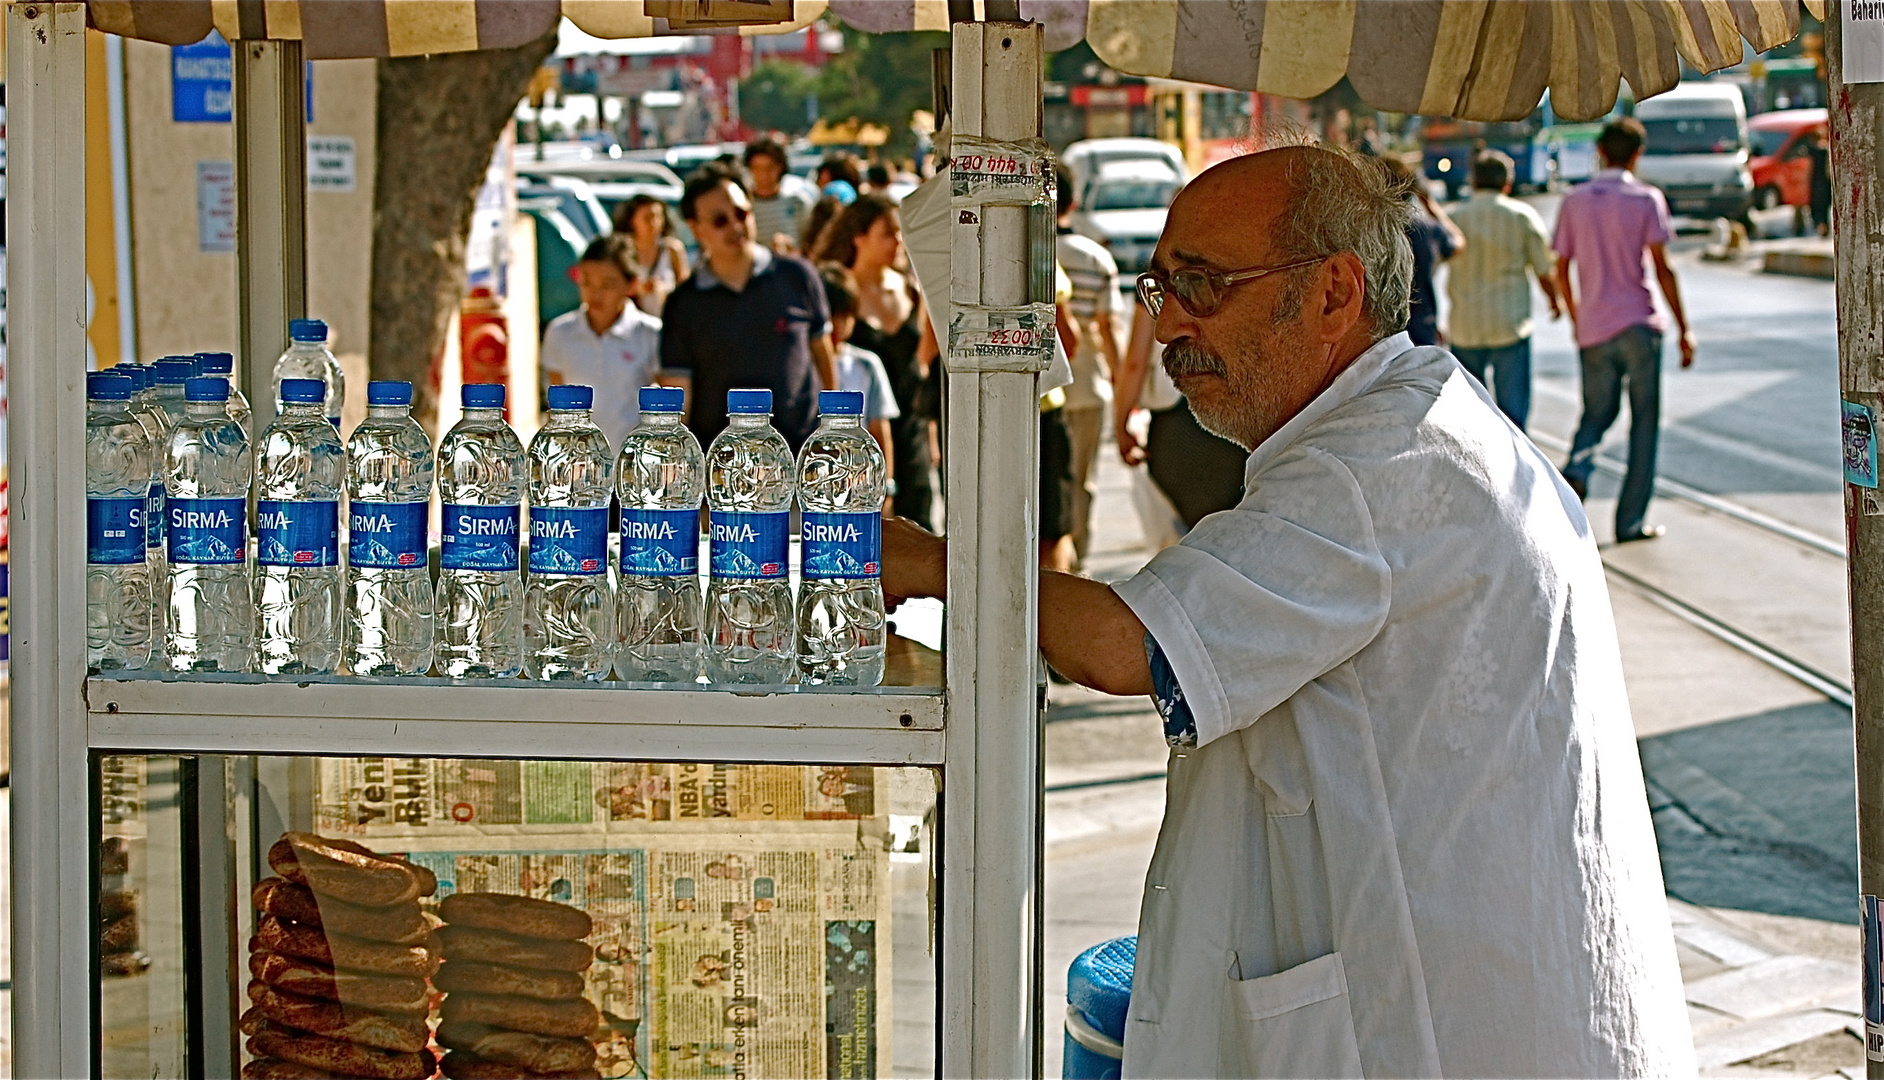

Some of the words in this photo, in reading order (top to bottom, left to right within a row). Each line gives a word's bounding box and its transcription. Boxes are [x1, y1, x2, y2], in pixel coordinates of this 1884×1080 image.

[172, 509, 232, 529] SIRMA
[350, 513, 397, 533] IRMA
[458, 515, 517, 535] SIRMA
[621, 517, 678, 540] SIRMA
[803, 521, 862, 543] SIRMA
[357, 757, 386, 825] Yeni
[731, 974, 746, 1002] tanı
[731, 1006, 746, 1048] erken
